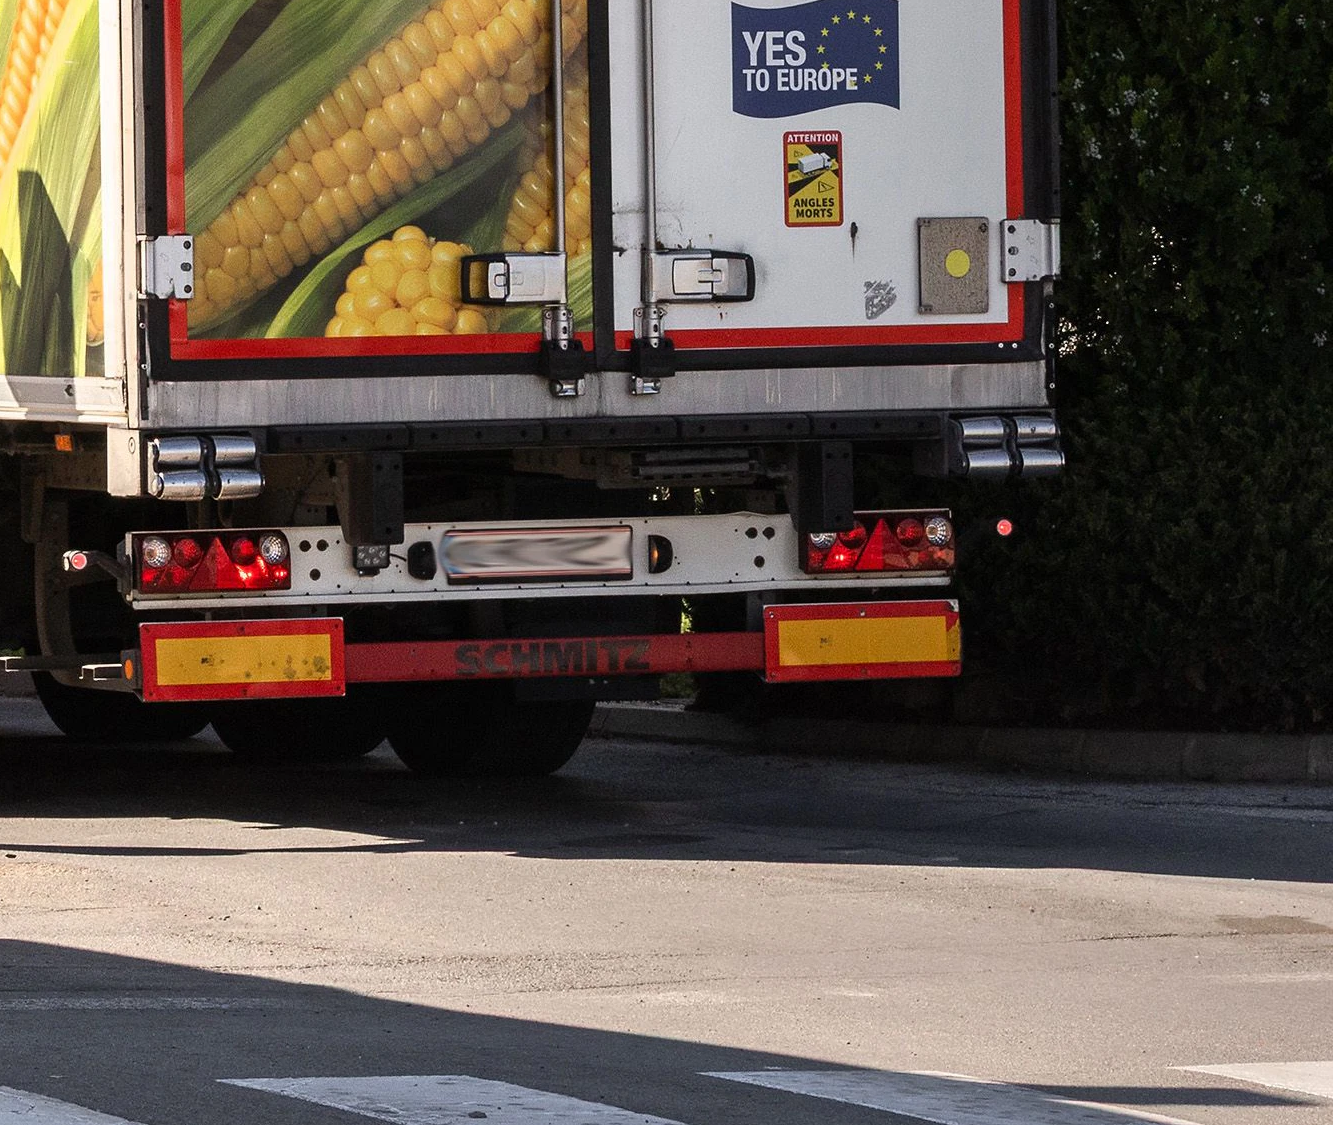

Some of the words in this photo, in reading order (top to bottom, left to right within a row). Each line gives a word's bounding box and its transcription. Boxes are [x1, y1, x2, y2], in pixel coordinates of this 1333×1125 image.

[742, 30, 807, 67] YES
[743, 69, 769, 92] TO
[777, 68, 858, 91] EUROPE
[788, 134, 838, 143] ATTENTION
[794, 198, 834, 207] ANGLES
[796, 209, 832, 218] MORTS
[455, 639, 651, 676] SCHMITZ
